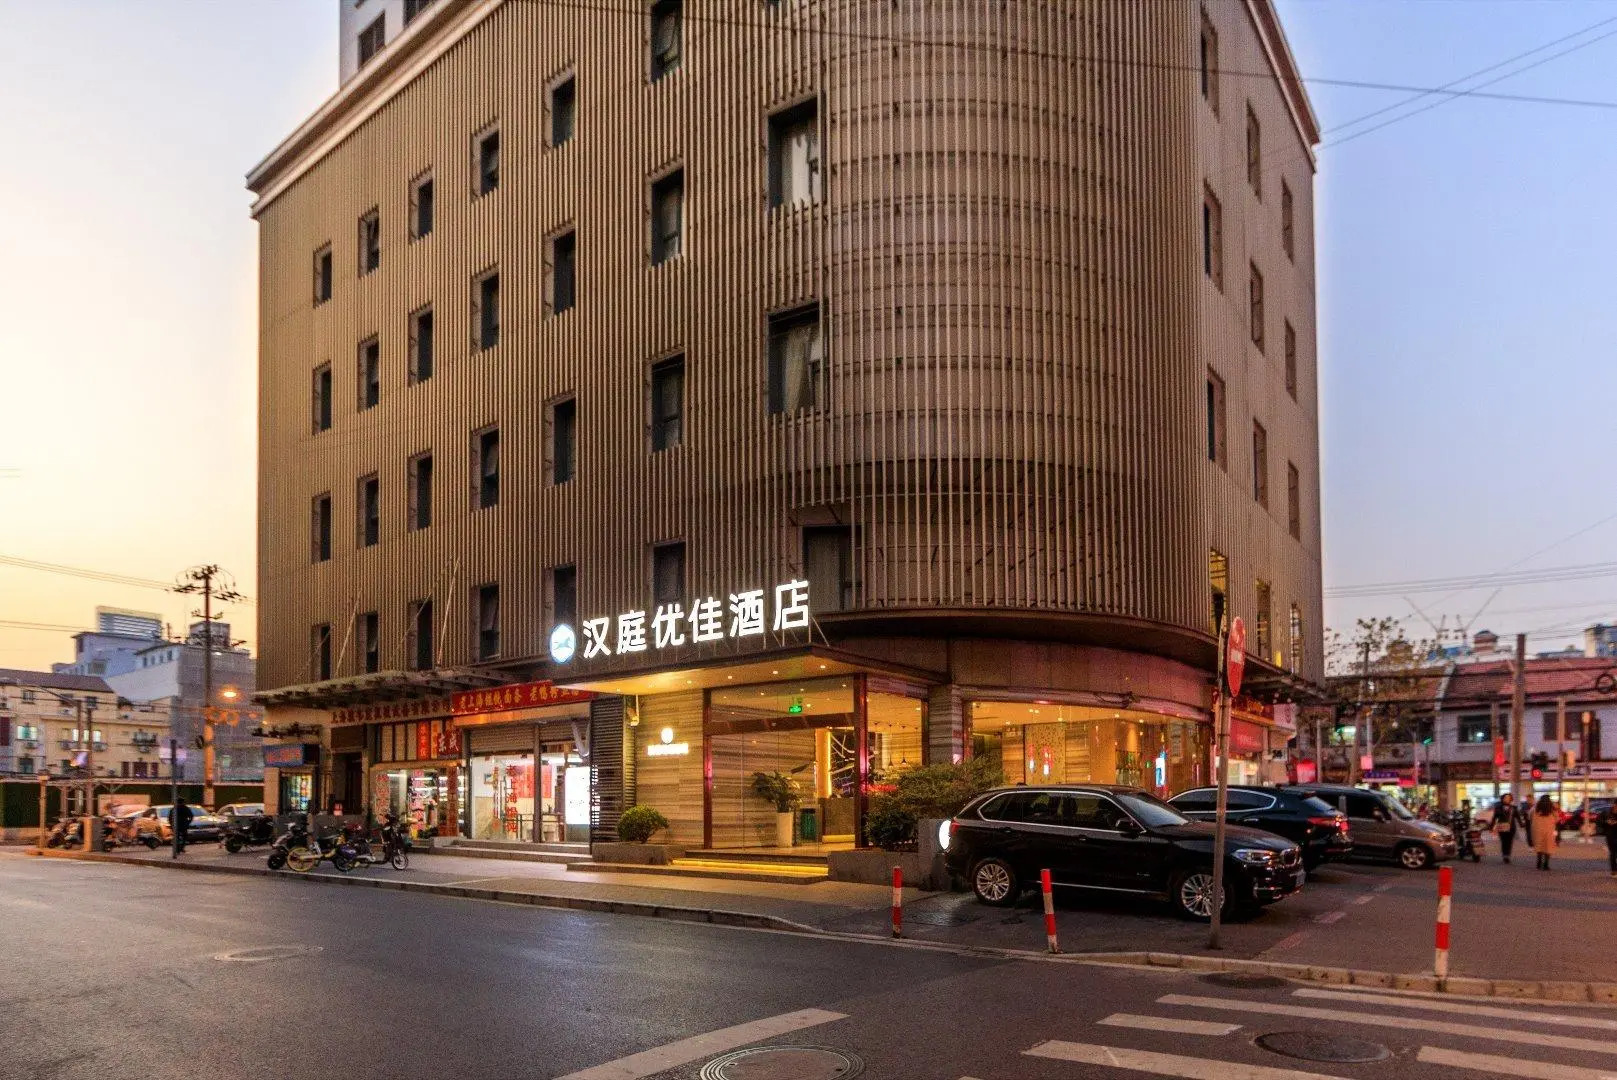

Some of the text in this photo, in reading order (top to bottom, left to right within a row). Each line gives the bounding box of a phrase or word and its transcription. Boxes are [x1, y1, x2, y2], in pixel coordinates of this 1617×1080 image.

[582, 579, 809, 658] 汉庭优佳酒店
